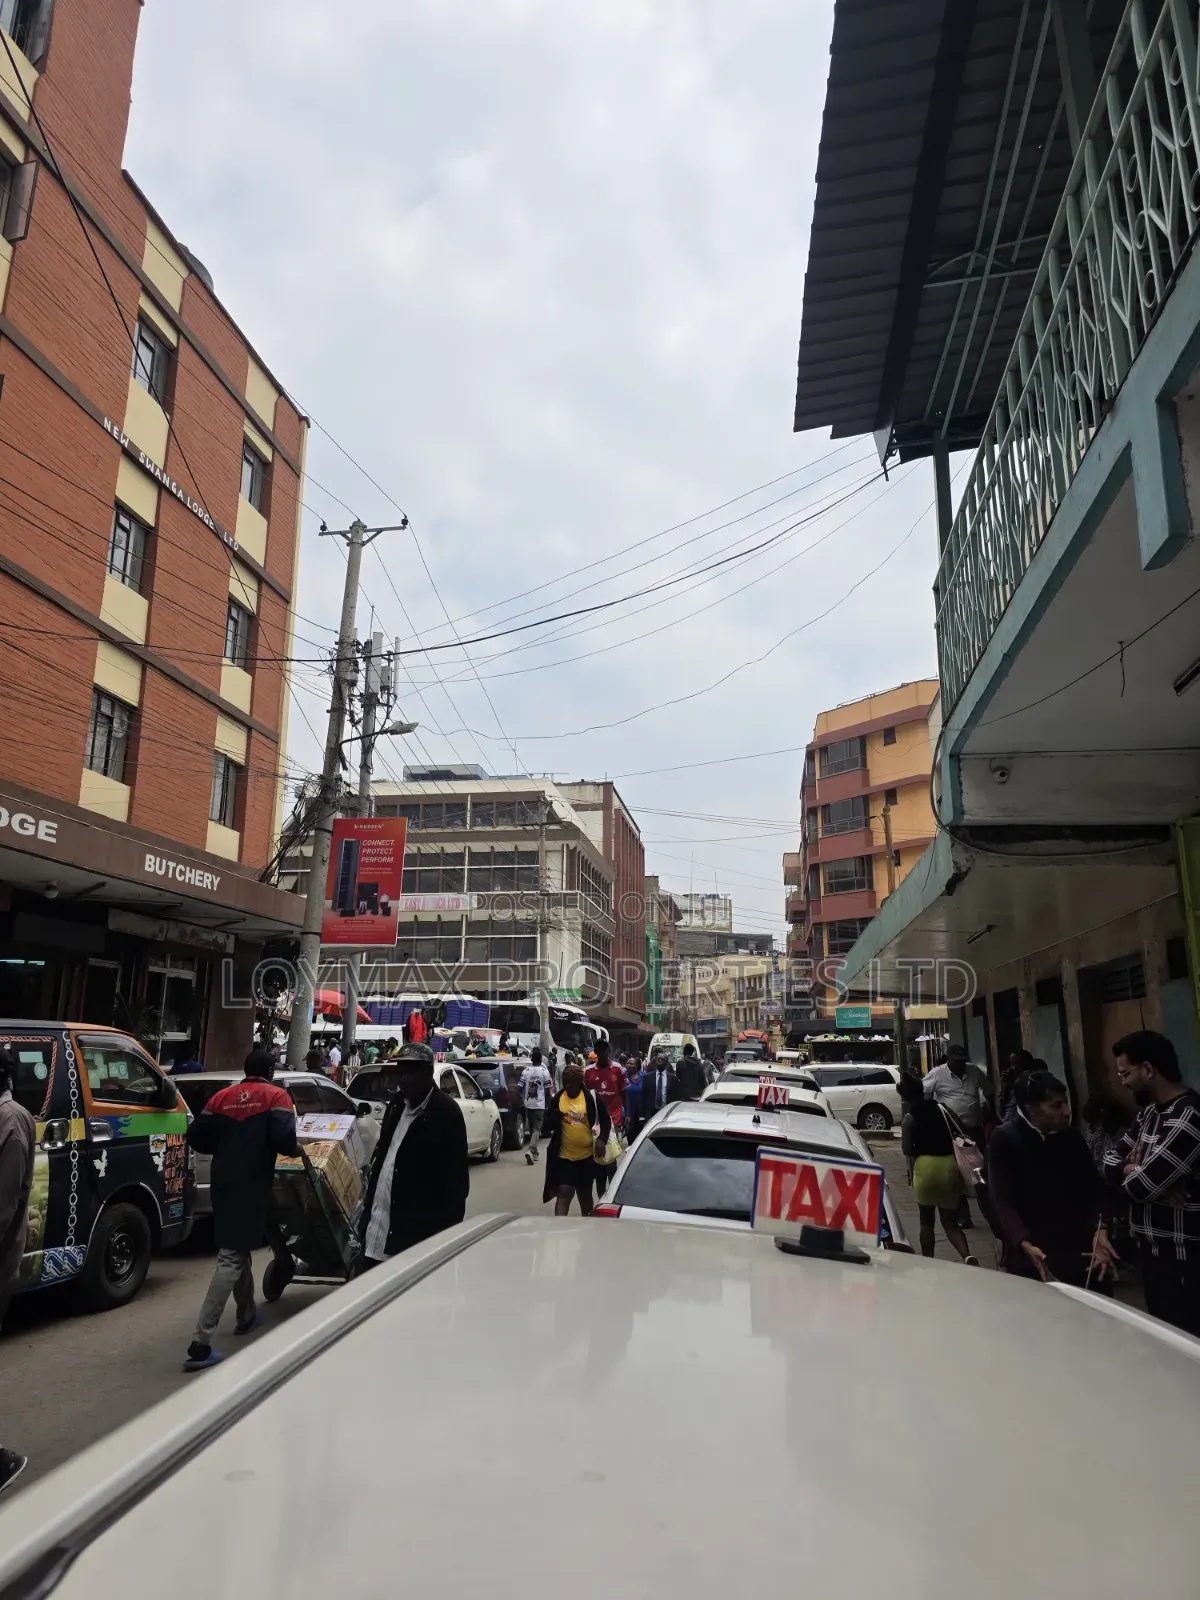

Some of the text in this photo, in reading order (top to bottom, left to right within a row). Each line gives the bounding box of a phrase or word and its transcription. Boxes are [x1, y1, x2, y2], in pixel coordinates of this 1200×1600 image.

[103, 416, 239, 552] NEW SWANGA LODGE LTD
[144, 853, 221, 892] BUTCHERY
[759, 1076, 776, 1085] TAXI
[759, 1085, 791, 1105] TAXI
[758, 1157, 881, 1235] TAXI
